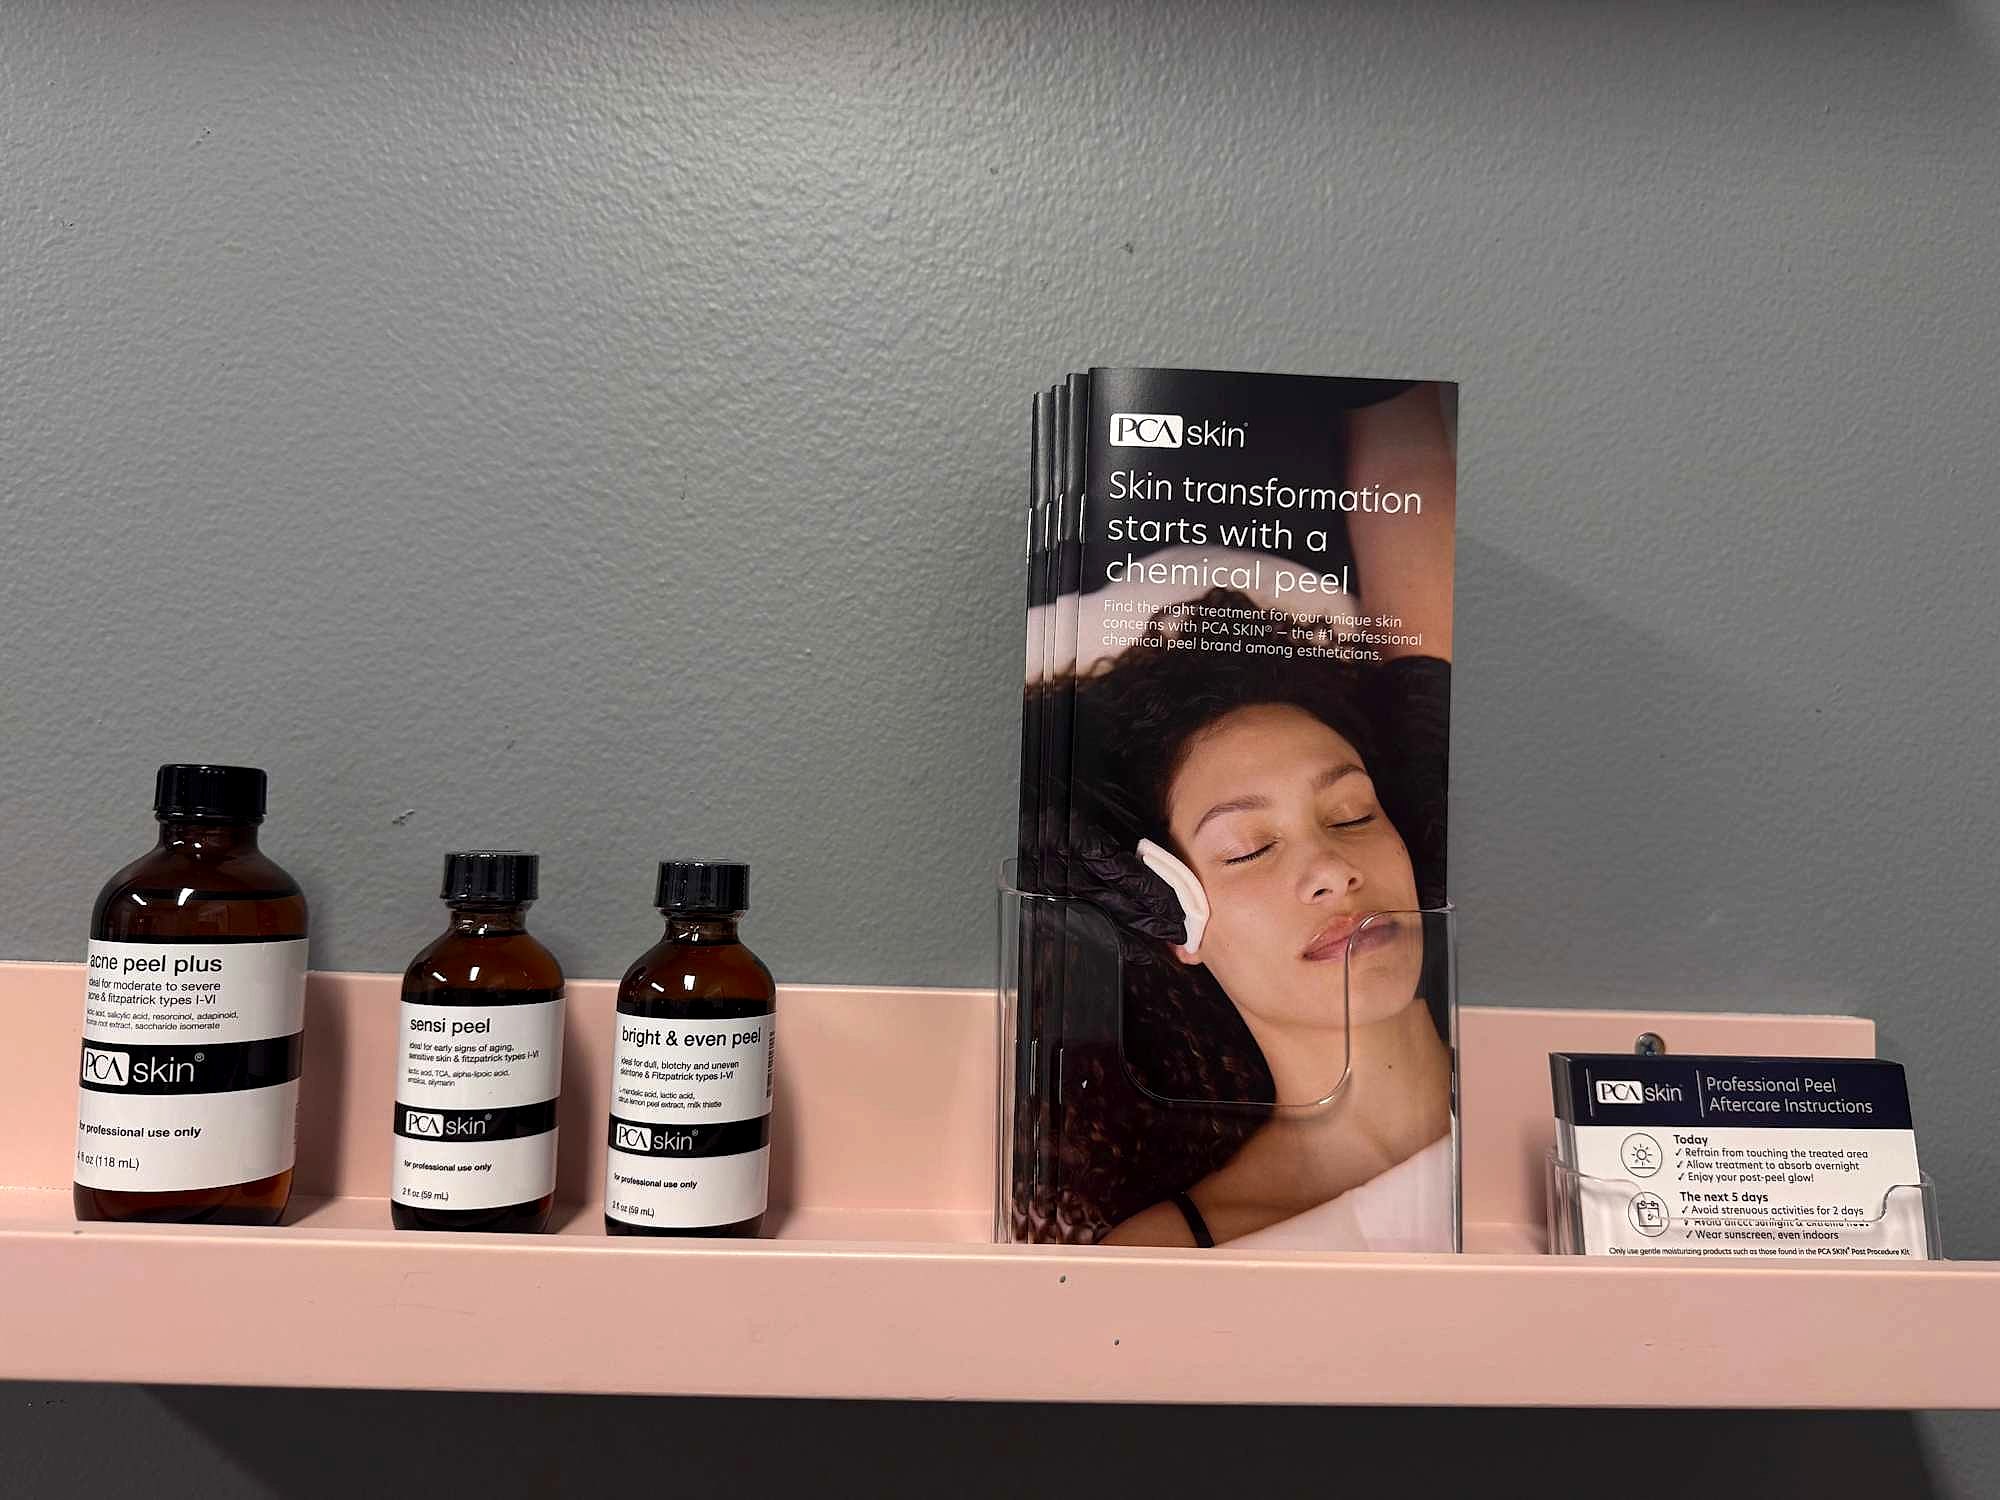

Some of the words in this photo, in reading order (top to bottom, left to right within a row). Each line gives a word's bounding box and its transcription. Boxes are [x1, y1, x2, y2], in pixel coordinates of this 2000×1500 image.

[1118, 418, 1177, 444] PCA
[1109, 471, 1172, 501] Skin
[1183, 475, 1421, 515] transformation
[1107, 516, 1207, 544] starts
[1220, 519, 1293, 550] with
[1306, 530, 1327, 552] a
[1106, 553, 1260, 590] chemical
[1275, 566, 1348, 598] peel
[1104, 600, 1133, 613] Find
[1137, 600, 1159, 614] the
[1162, 603, 1195, 617] right
[1199, 605, 1266, 620] treatment
[1270, 608, 1288, 622] for
[1291, 612, 1321, 625] your
[1325, 613, 1372, 627] unique
[1375, 614, 1402, 628] skin
[1103, 618, 1164, 631] concerns
[1168, 620, 1197, 633] with
[1201, 621, 1230, 634] PCA
[1291, 626, 1313, 640] the
[1318, 629, 1333, 641] #1
[1337, 631, 1422, 646] professional
[1102, 633, 1163, 648] chemical
[1167, 637, 1197, 651] peel
[1200, 637, 1242, 652] brand
[1245, 643, 1293, 658] among
[1297, 645, 1383, 661] estheticians.
[90, 954, 118, 970] acne
[123, 955, 166, 975] peel
[174, 955, 223, 976] plus
[101, 978, 111, 989] for
[113, 980, 162, 991] moderate
[166, 982, 178, 991] to
[181, 982, 221, 991] severe
[100, 992, 106, 1002] &
[108, 993, 156, 1005] fitzpatrick
[159, 995, 192, 1007] types
[196, 994, 216, 1005] I-VI
[132, 1012, 150, 1021] acid,
[135, 1022, 177, 1030] saccharide
[179, 1022, 220, 1030] isomerate
[410, 1018, 446, 1032] sensi
[452, 1018, 490, 1036] peel
[622, 1026, 661, 1047] bright
[666, 1030, 678, 1046] &
[684, 1034, 726, 1046] even
[732, 1027, 761, 1049] peel
[434, 1044, 452, 1053] early
[455, 1045, 476, 1054] signs
[478, 1044, 487, 1052] of
[489, 1044, 514, 1052] aging,
[436, 1054, 451, 1062] skin
[462, 1054, 503, 1064] fitzpatrick
[505, 1053, 526, 1062] types
[634, 1058, 643, 1068] for
[643, 1059, 658, 1069] dull,
[661, 1059, 691, 1071] blotchy
[694, 1060, 709, 1070] and
[711, 1061, 739, 1069] uneven
[86, 1052, 124, 1081] PCA
[644, 1071, 650, 1079] &
[651, 1071, 693, 1081] Fitzpatrick
[695, 1072, 718, 1082] types
[1706, 1076, 1800, 1092] Professional
[1804, 1077, 1837, 1093] Peel
[1601, 1083, 1640, 1101] PCA
[1709, 1096, 1781, 1112] Aftercare
[1785, 1098, 1873, 1113] Instructions
[409, 1114, 440, 1134] PCA
[86, 1124, 144, 1137] professional
[148, 1129, 170, 1137] use
[174, 1126, 202, 1139] only
[619, 1126, 648, 1148] PCA
[1673, 1134, 1708, 1146] Today
[1685, 1147, 1719, 1158] Refrain
[1722, 1148, 1744, 1158] from
[1746, 1148, 1788, 1159] touching
[1790, 1149, 1806, 1158] the
[1808, 1149, 1843, 1158] treated
[86, 1155, 94, 1165] oz
[95, 1156, 115, 1168] (118
[118, 1158, 140, 1170] mL)
[412, 1162, 455, 1171] professional
[474, 1163, 492, 1172] only
[1687, 1160, 1713, 1169] Allow
[1715, 1161, 1763, 1170] treatment
[1765, 1161, 1775, 1170] to
[1778, 1161, 1812, 1170] absorb
[1814, 1162, 1860, 1172] overnight
[621, 1176, 661, 1188] professional
[680, 1181, 698, 1189] only
[1688, 1172, 1713, 1183] Enjoy
[1716, 1174, 1737, 1183] your
[1739, 1173, 1785, 1184] post-peel
[1788, 1173, 1814, 1183] glow!
[421, 1191, 432, 1199] (59
[434, 1192, 449, 1201] mL)
[1680, 1191, 1700, 1202] The
[1704, 1192, 1729, 1202] next
[1731, 1192, 1738, 1202] 5
[1741, 1192, 1768, 1204] days
[628, 1205, 639, 1214] (59
[640, 1207, 655, 1218] mL)
[1691, 1206, 1718, 1214] Avoid
[1721, 1206, 1768, 1215] strenuous
[1771, 1205, 1814, 1215] activities
[1816, 1206, 1830, 1215] for
[1833, 1206, 1838, 1214] 2
[1841, 1206, 1863, 1216] days
[1695, 1230, 1721, 1239] Wear
[1724, 1231, 1775, 1240] sunscreen,
[1777, 1231, 1800, 1239] even
[1803, 1230, 1839, 1239] indoors
[1609, 1247, 1626, 1255] Only
[1640, 1247, 1661, 1255] gentle
[1662, 1247, 1701, 1255] moisturizing
[1702, 1247, 1731, 1255] products
[1733, 1247, 1748, 1255] such
